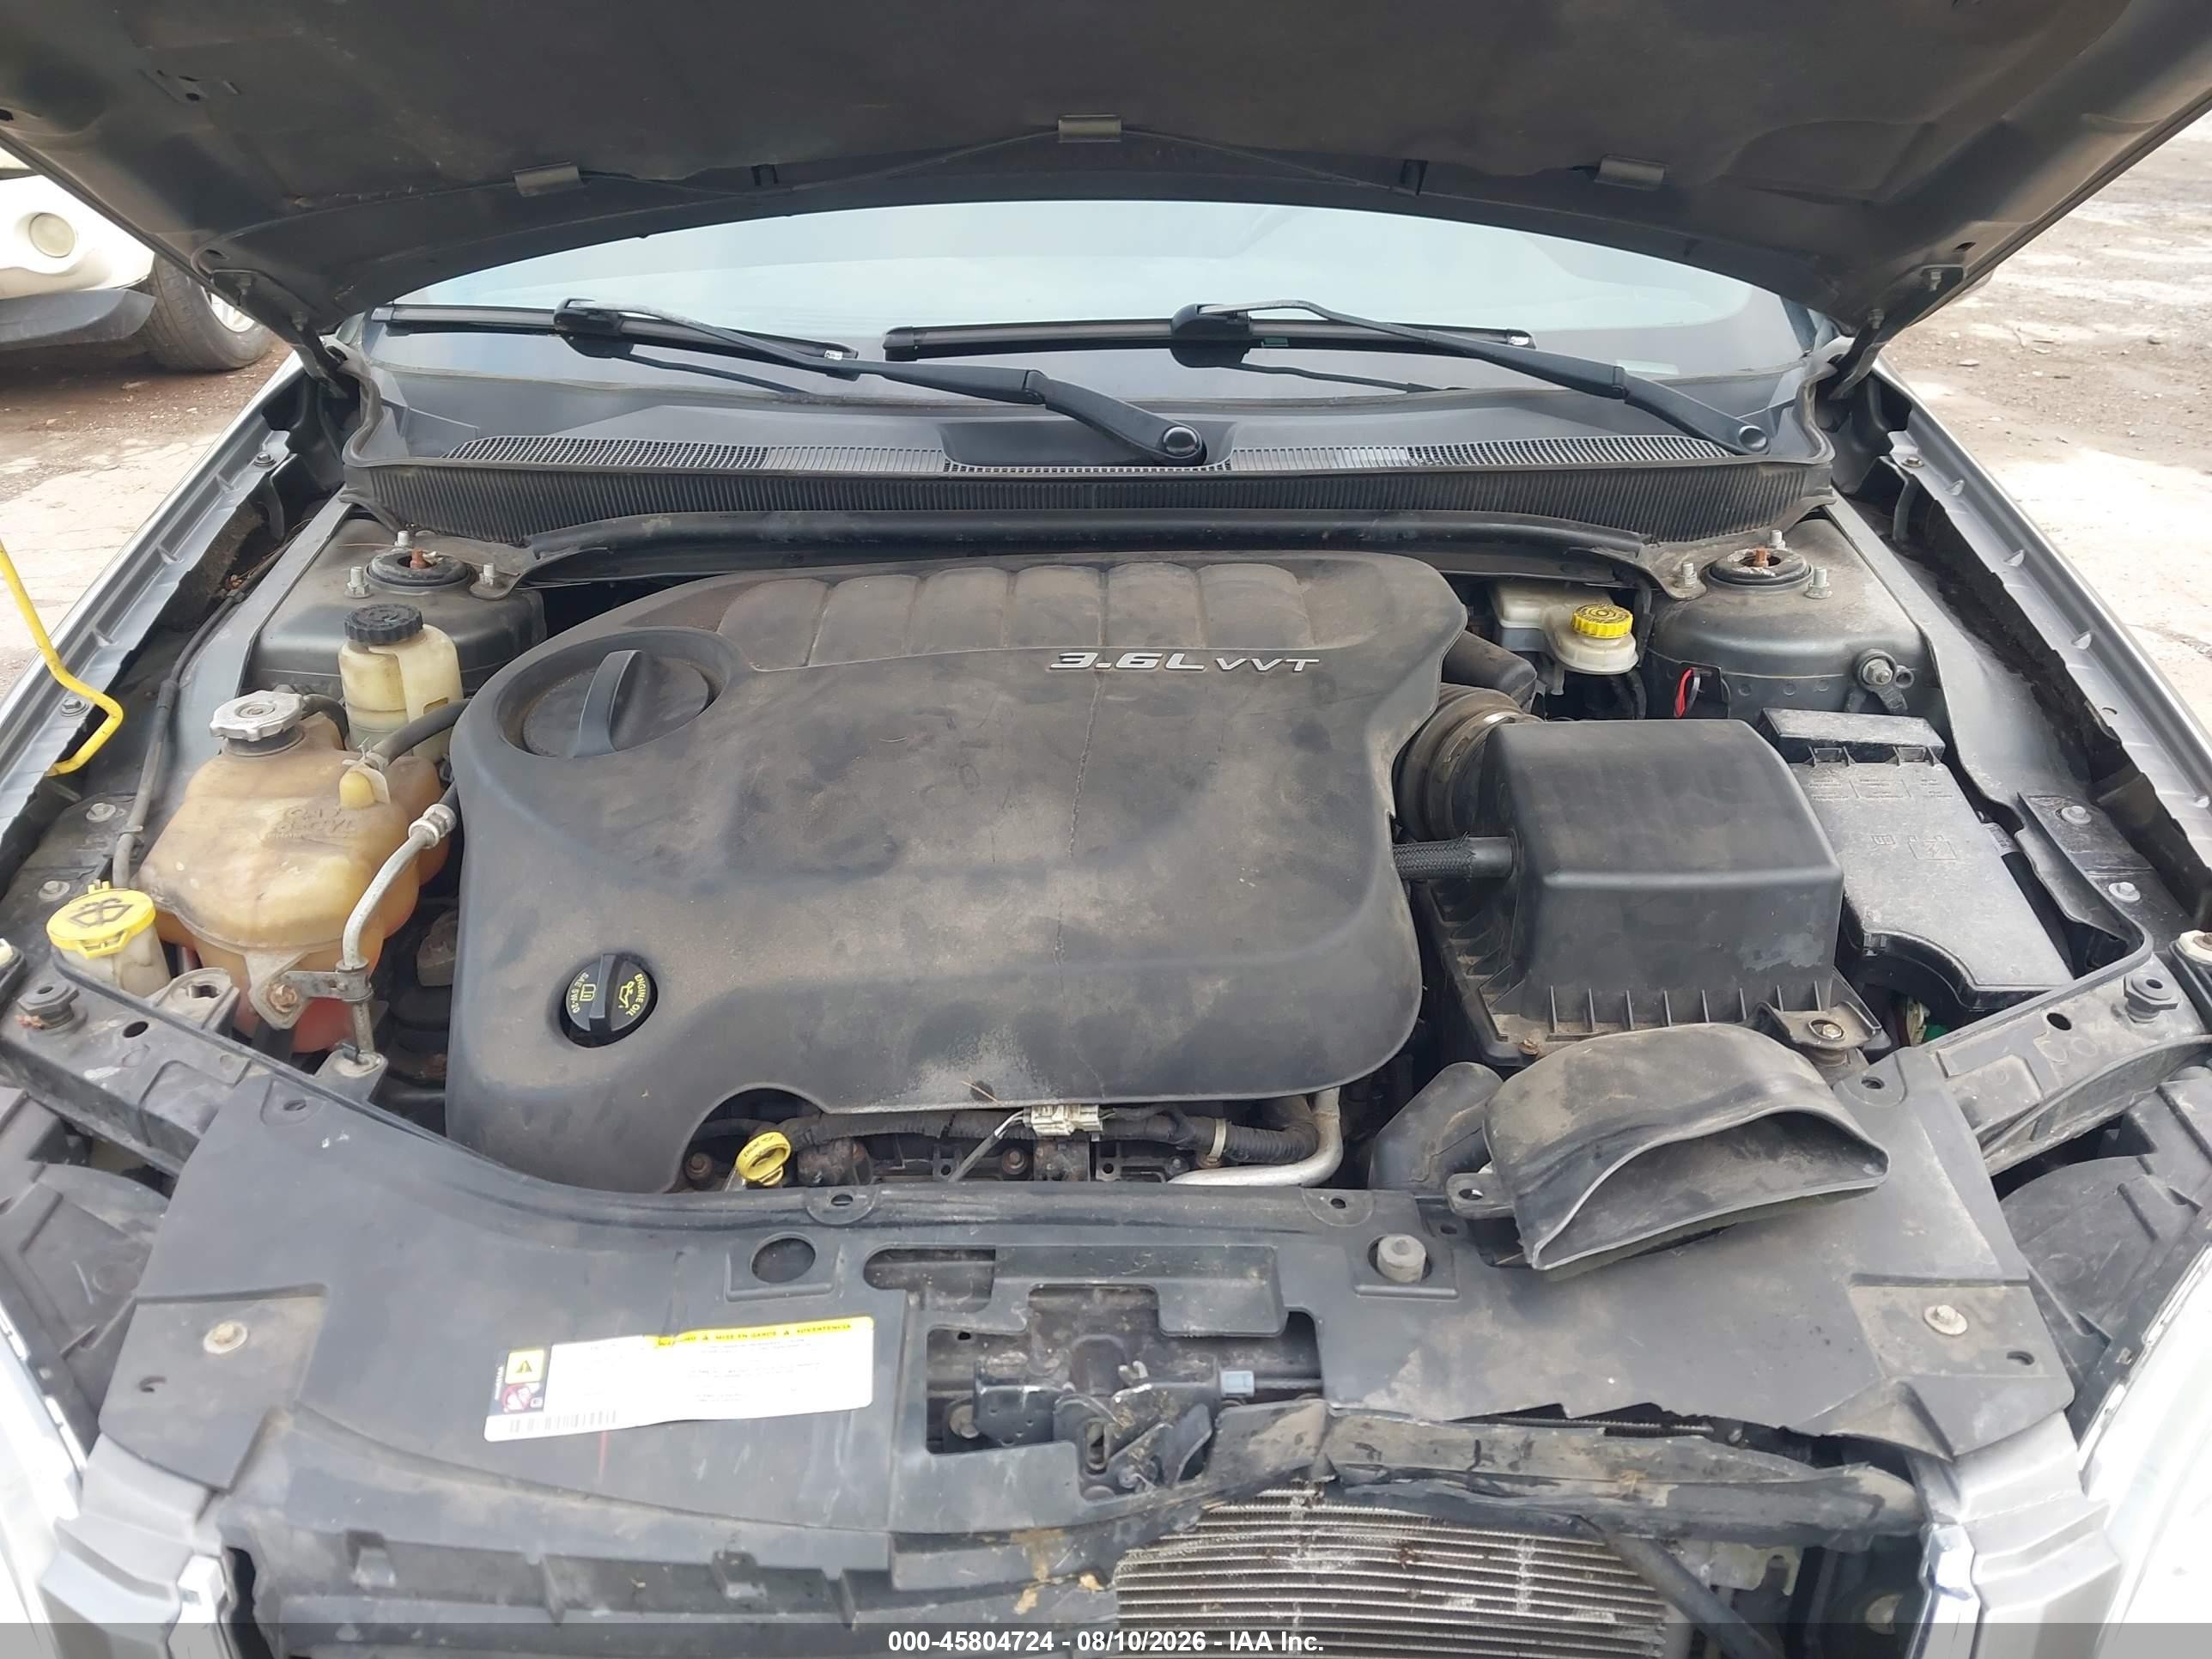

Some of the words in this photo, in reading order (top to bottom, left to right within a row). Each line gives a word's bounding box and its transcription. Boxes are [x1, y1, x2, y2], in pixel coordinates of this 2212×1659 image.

[1049, 652, 1206, 672] 3.6L
[1215, 657, 1320, 672] VVT
[574, 972, 590, 988] SAE
[634, 973, 647, 1003] ENGINE
[570, 988, 580, 1014] 5W-20
[625, 1004, 641, 1017] OIL
